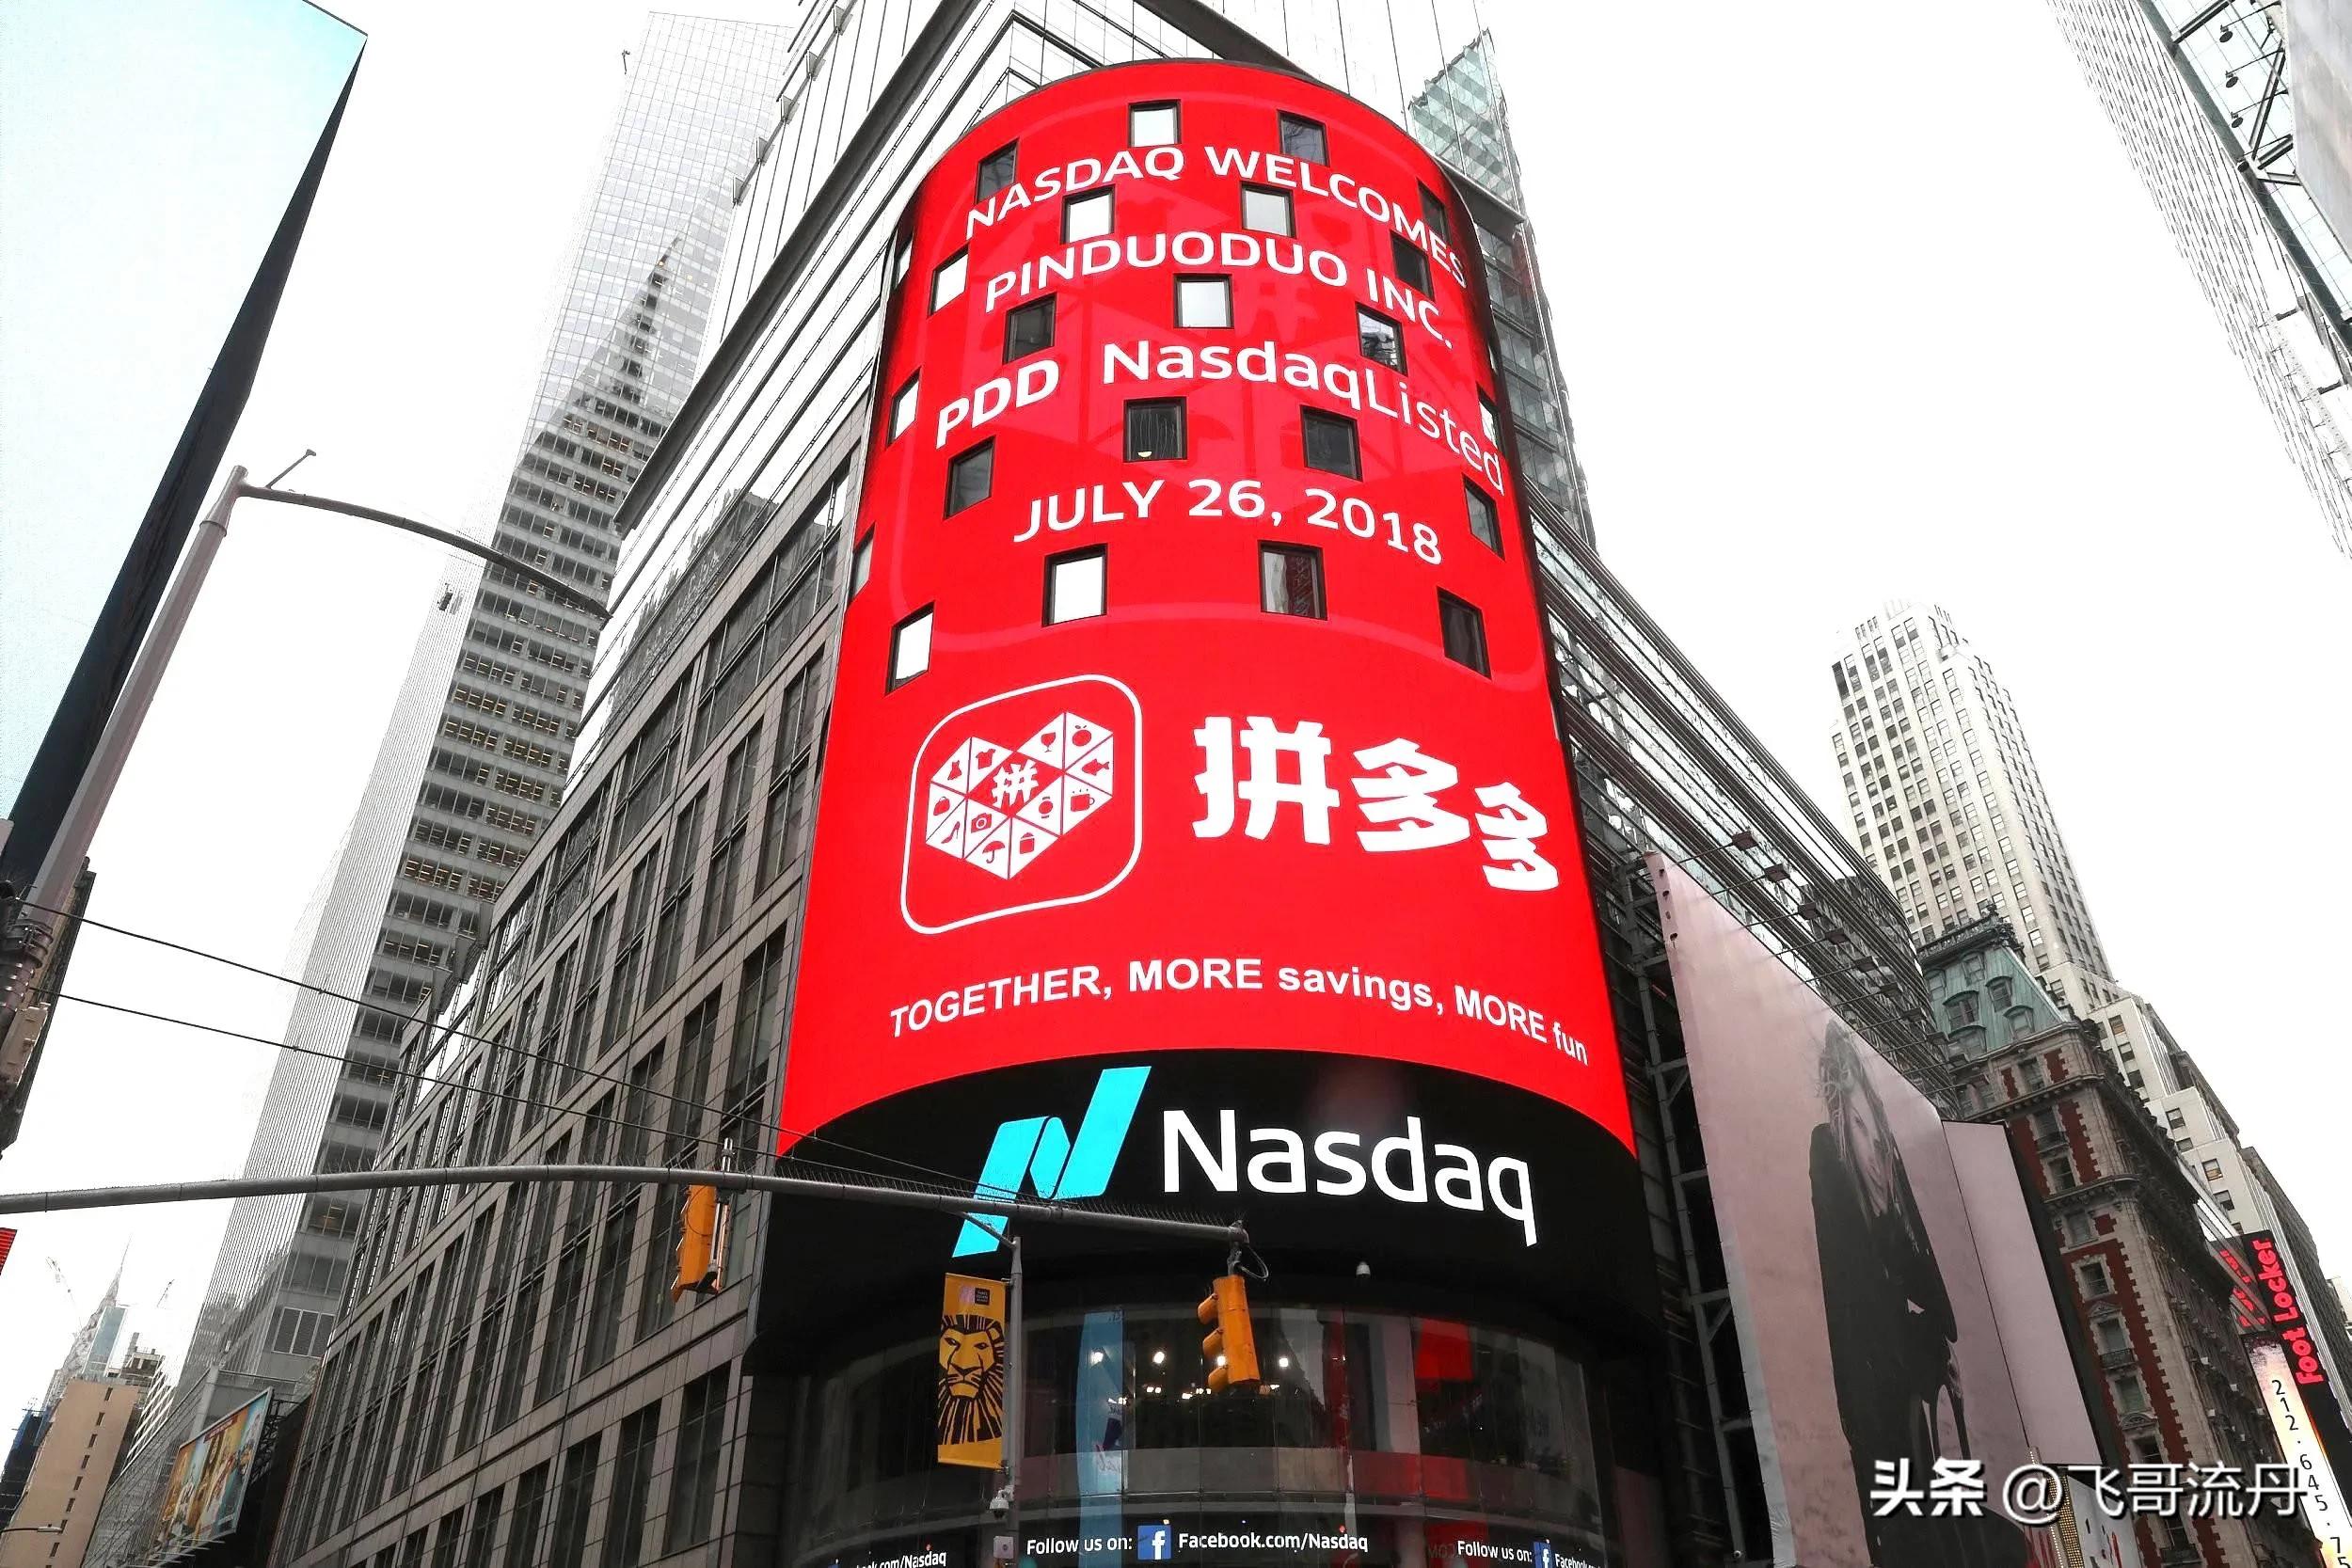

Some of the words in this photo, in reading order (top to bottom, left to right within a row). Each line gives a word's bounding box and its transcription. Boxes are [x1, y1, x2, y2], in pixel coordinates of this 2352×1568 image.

[966, 143, 1184, 240] NASDAQ
[1204, 146, 1468, 290] WELCOMES
[985, 230, 1348, 313] PINDUODUO
[1366, 268, 1453, 349] INC.
[936, 359, 1059, 450] PDD
[1013, 479, 1165, 543] JULY
[1187, 478, 1282, 527] 26,
[1305, 488, 1442, 565] 2018
[1192, 716, 1560, 892] 拼多多
[890, 965, 1112, 1037] TOGETHER,
[1129, 958, 1263, 992] MORE
[1278, 966, 1444, 1016] savings,
[1454, 985, 1548, 1043] MORE
[1552, 1022, 1588, 1066] fun
[1163, 1110, 1537, 1247] Nasdaq
[2252, 1238, 2299, 1323] Locker
[2281, 1327, 2324, 1385] Foot
[1026, 1537, 1080, 1555] Follow
[1084, 1538, 1103, 1552] us
[1106, 1537, 1133, 1551] on:
[1179, 1532, 1369, 1552] Facebook.com/Nasdaq
[1457, 1540, 1499, 1559] Follow
[1501, 1546, 1515, 1560] us
[1516, 1549, 1533, 1562] on:
